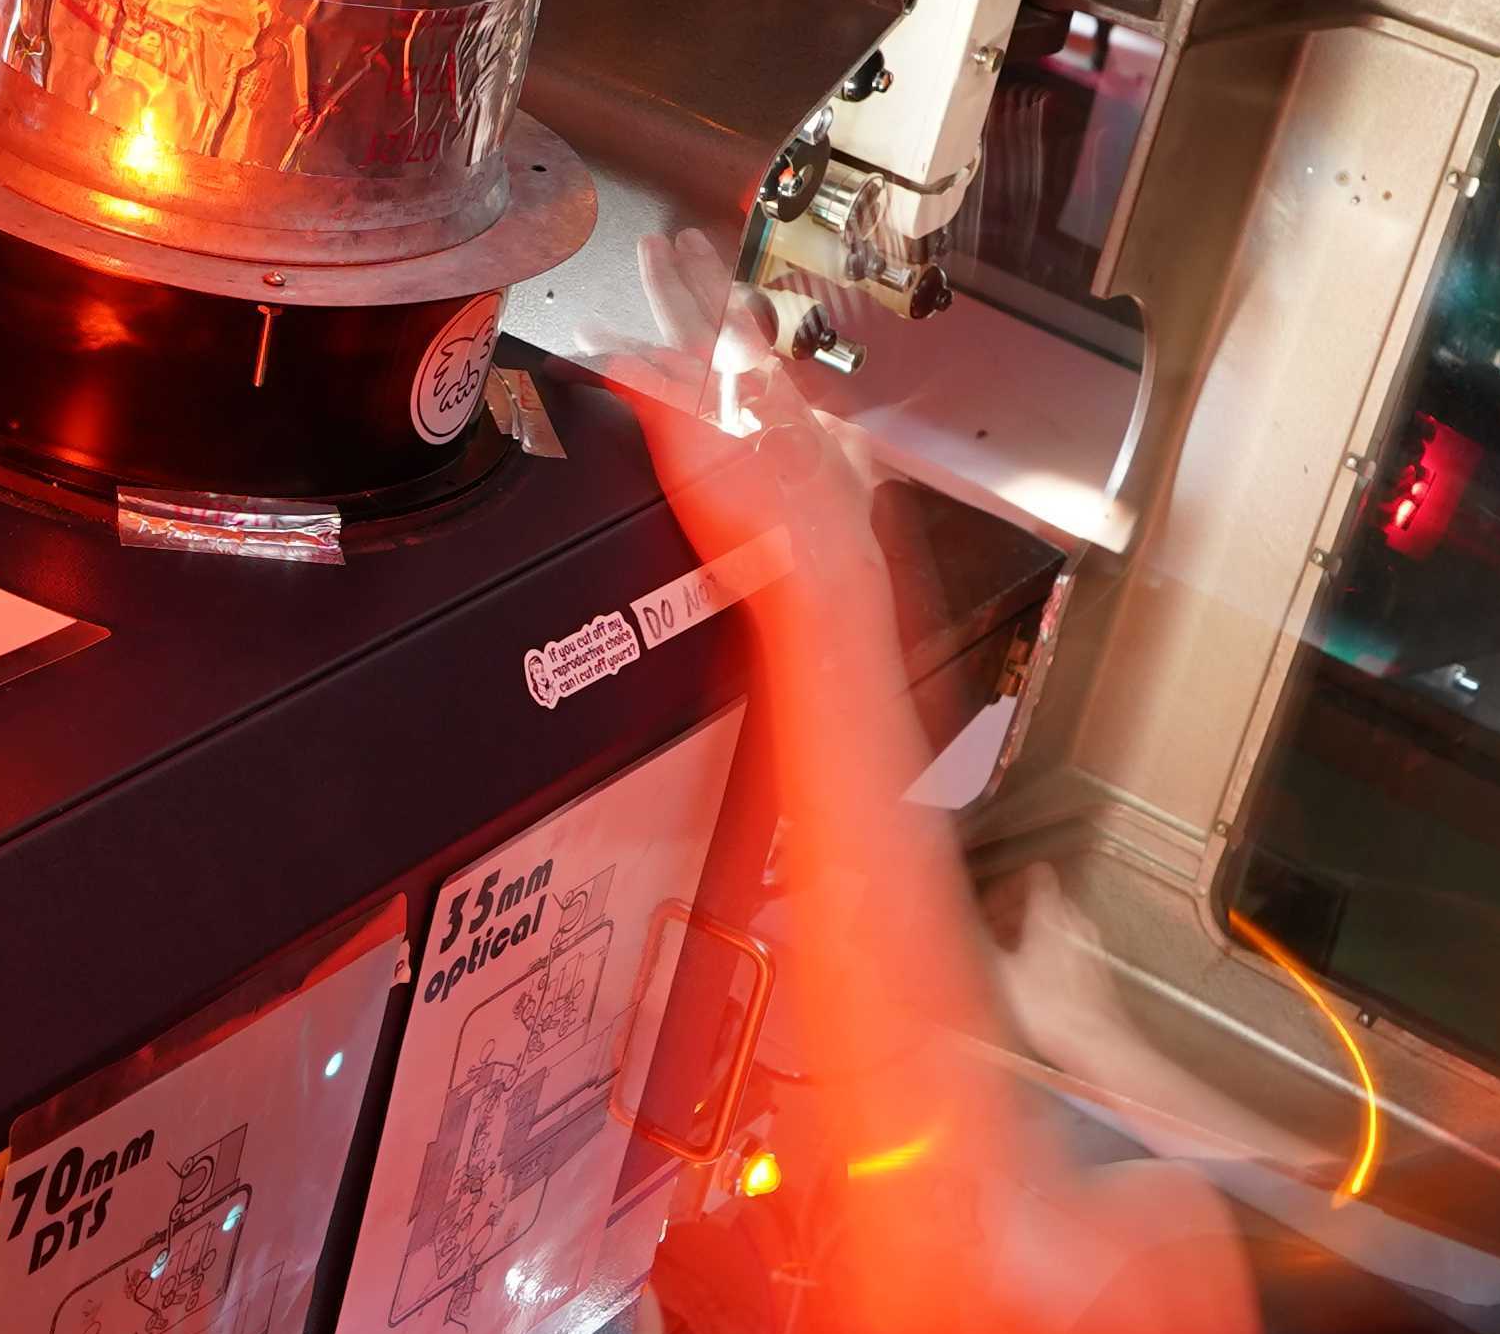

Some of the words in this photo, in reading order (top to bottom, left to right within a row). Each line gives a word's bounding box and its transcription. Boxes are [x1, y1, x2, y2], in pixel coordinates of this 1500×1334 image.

[551, 643, 606, 680] reproductive
[604, 628, 633, 654] choice
[557, 640, 578, 664] you
[576, 632, 593, 651] cut
[592, 621, 607, 642] off
[606, 615, 625, 635] my
[642, 598, 675, 641] DO
[558, 675, 576, 694] can
[579, 666, 595, 685] cut
[593, 656, 609, 676] off
[607, 642, 638, 671] yours?
[438, 858, 554, 956] 35mm
[423, 893, 548, 1005] optical
[6, 1129, 156, 1243] 70mm
[27, 1186, 114, 1276] DTS
